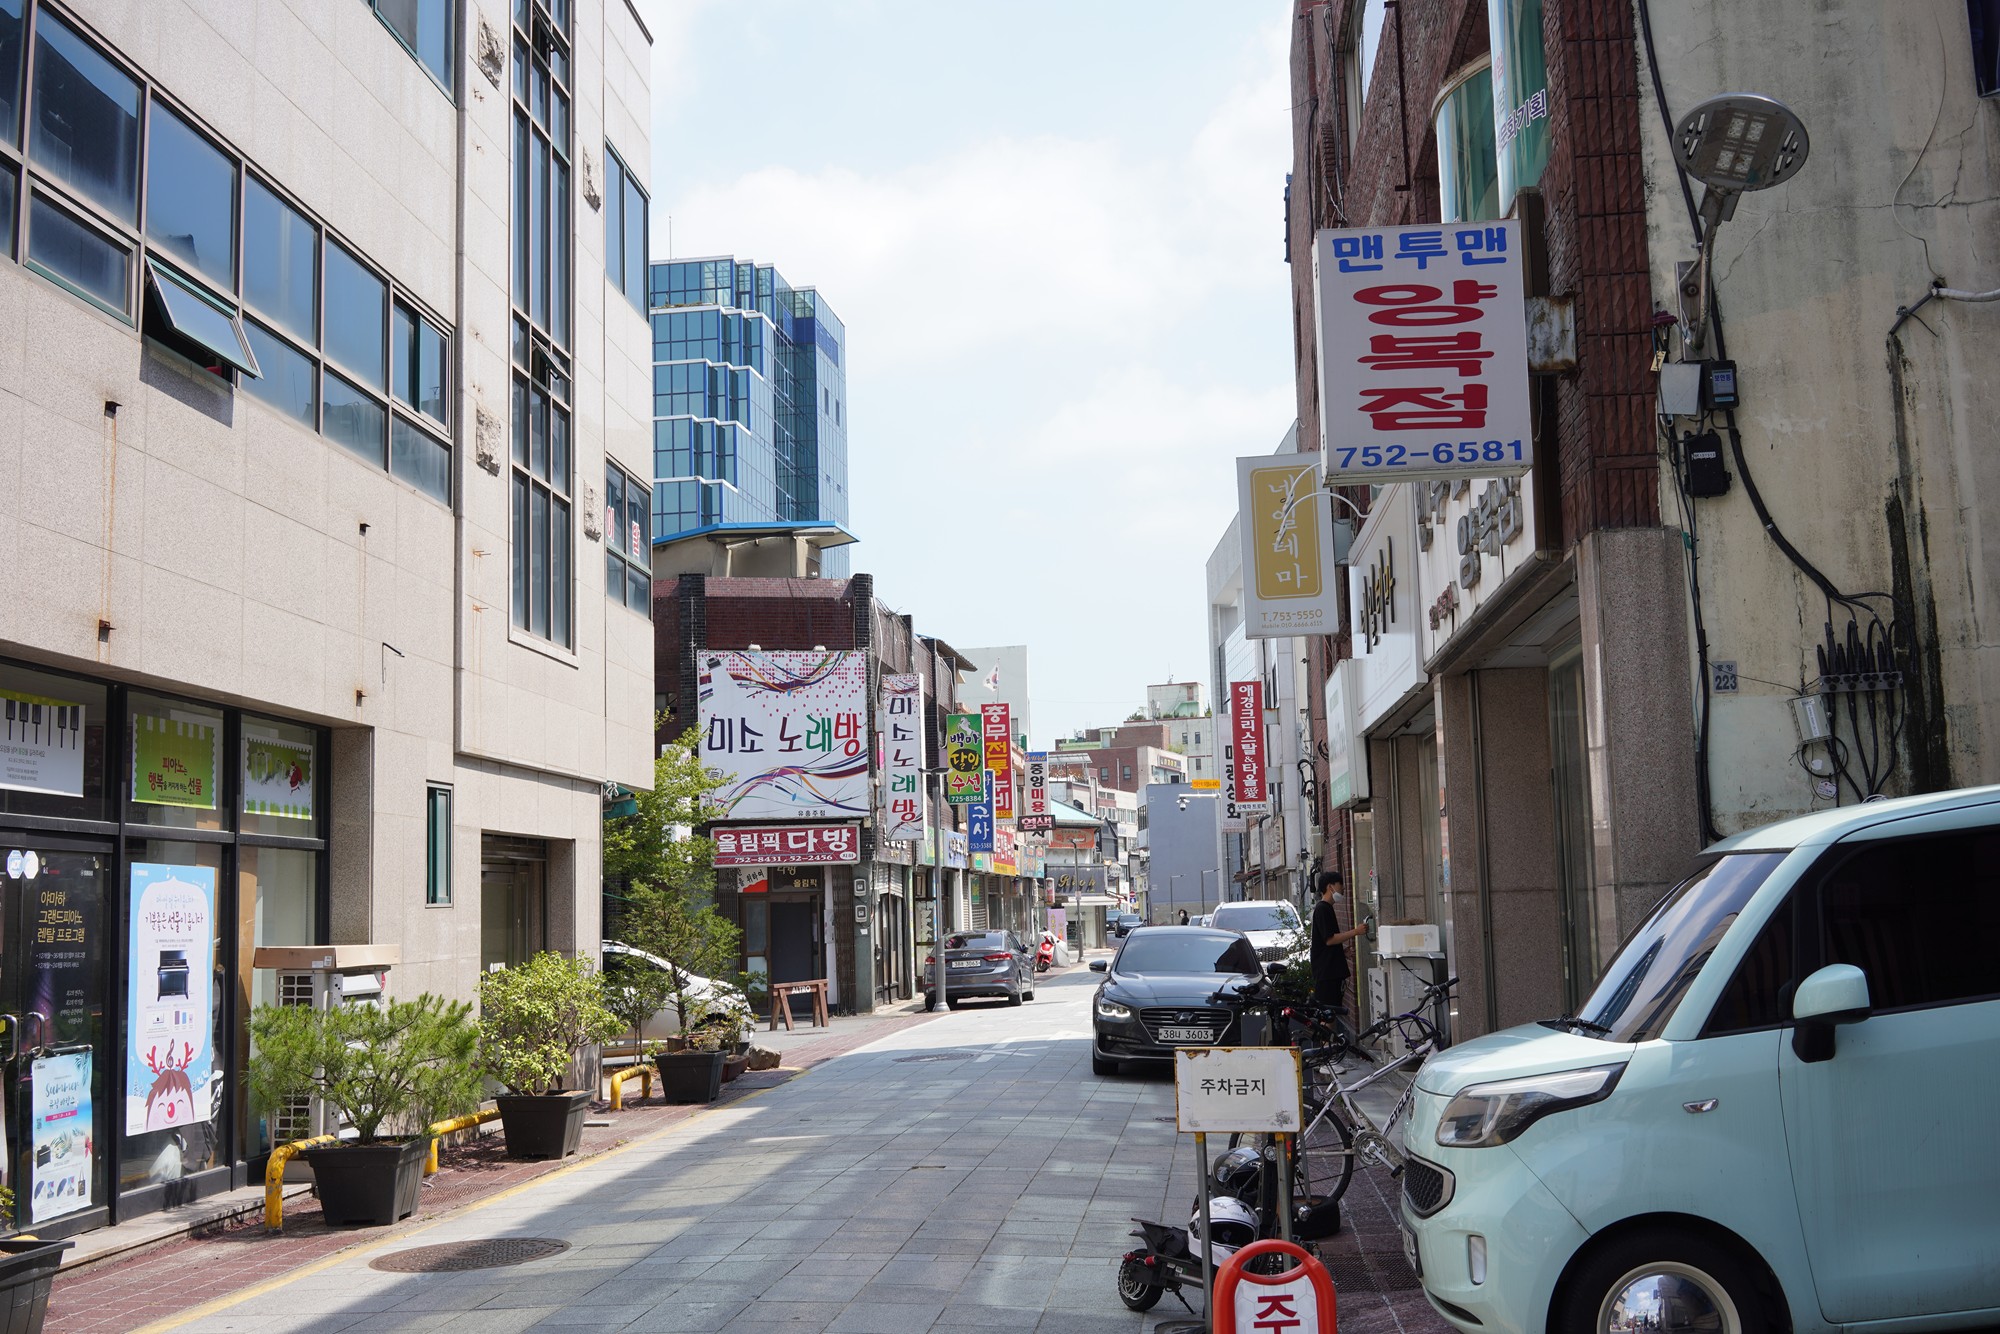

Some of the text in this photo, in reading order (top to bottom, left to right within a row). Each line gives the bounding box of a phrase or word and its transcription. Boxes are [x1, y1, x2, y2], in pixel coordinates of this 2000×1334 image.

[1332, 226, 1508, 274] 맨투맨
[1352, 278, 1499, 432] 양복점
[1335, 439, 1525, 469] 752-6581
[1261, 608, 1323, 622] T.753-5550
[1715, 674, 1737, 690] 223
[707, 712, 862, 757] 미소 노래방
[950, 732, 981, 747] 백마
[162, 757, 187, 775] 피아노는
[888, 697, 918, 822] 미소노래방
[950, 751, 980, 770] 달인
[188, 777, 203, 796] 선물
[951, 773, 982, 792] 수선
[951, 795, 982, 803] 725-8384
[797, 809, 826, 817] 유흥주점
[1021, 816, 1052, 829] 염색
[717, 828, 852, 853] 올림픽 다방
[793, 879, 817, 888] 올림픽
[40, 890, 66, 906] 야마하
[38, 909, 83, 925] 그랜드피아노
[37, 927, 86, 943] 렌탈 프로그램
[1185, 1030, 1210, 1041] 3603
[1200, 1077, 1266, 1097] 주차금지
